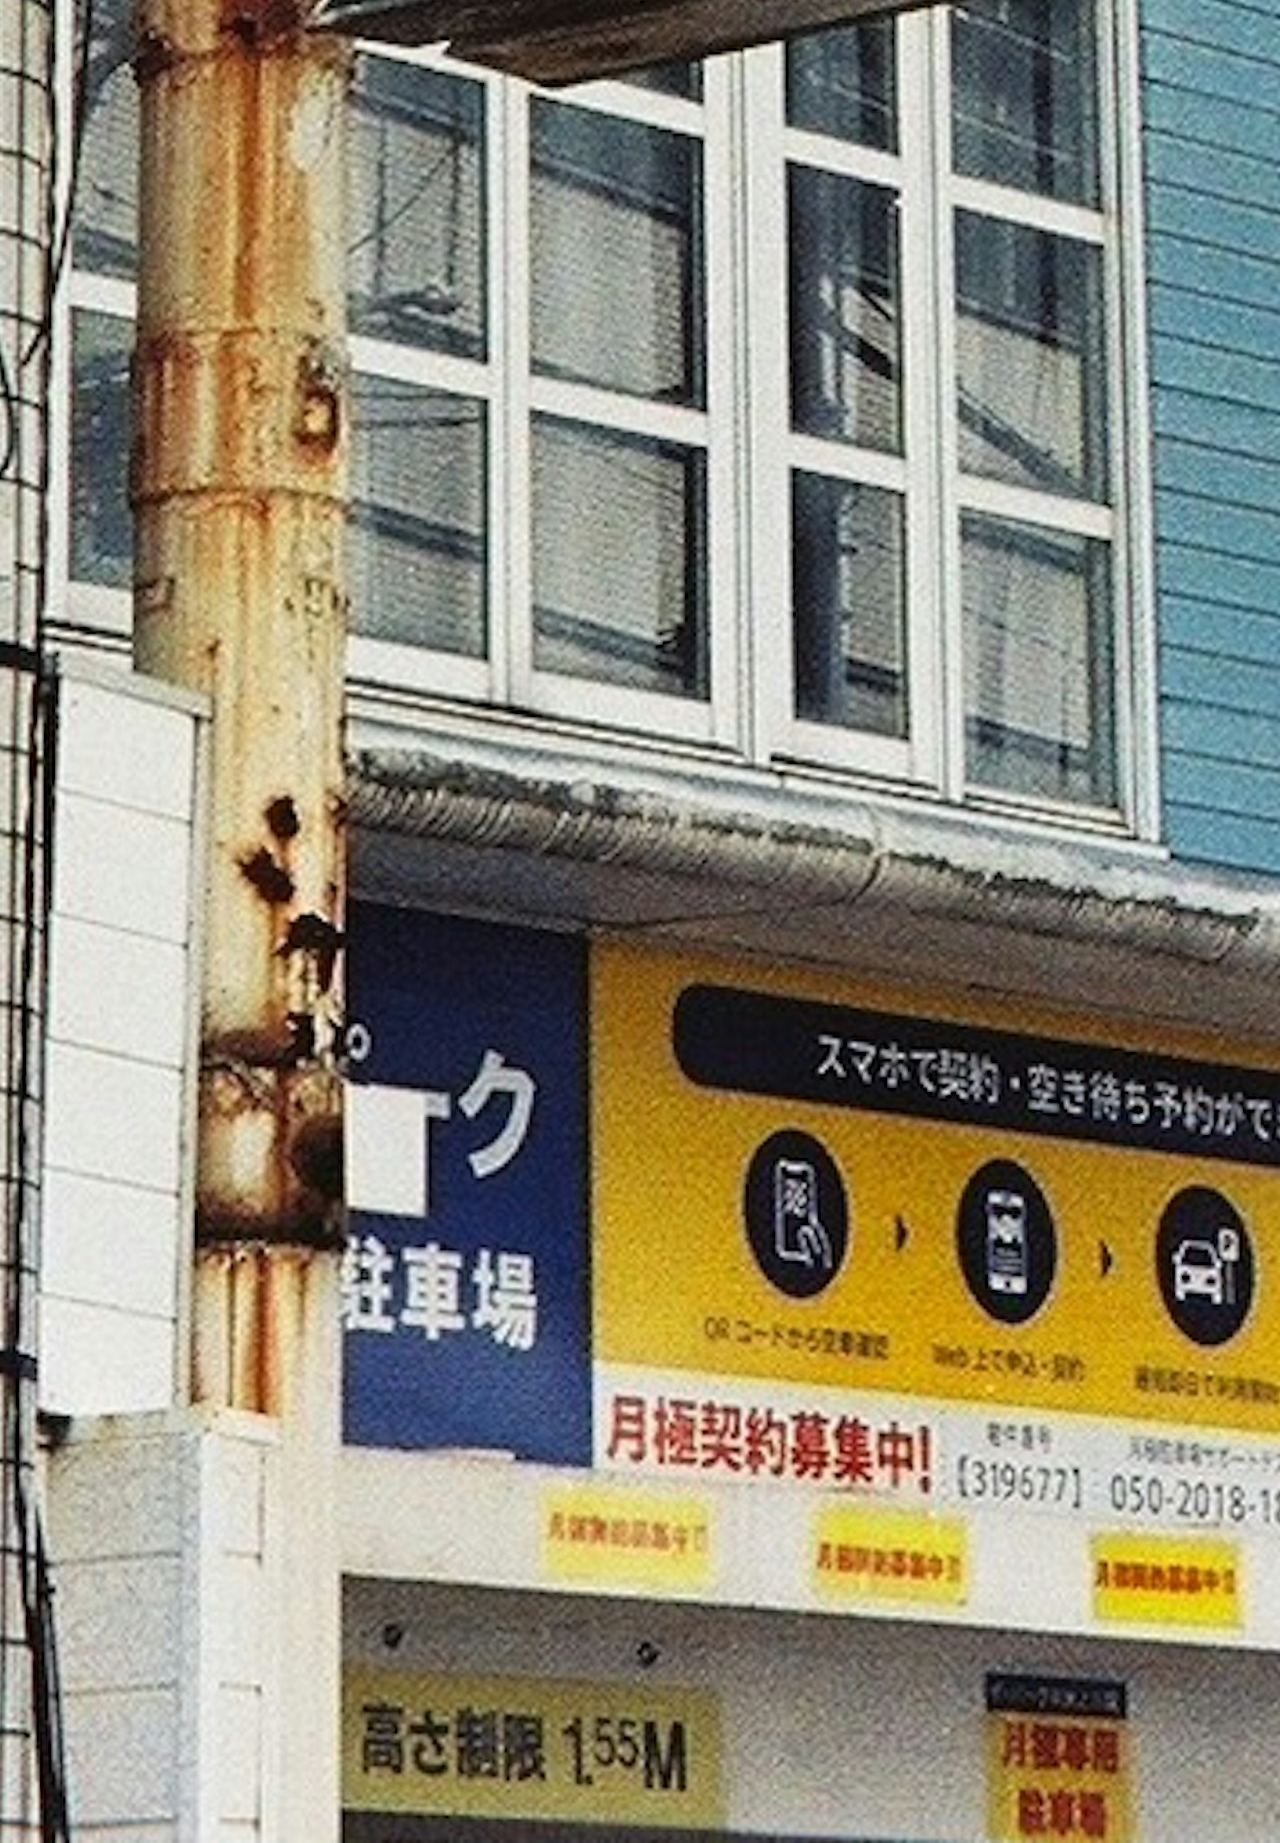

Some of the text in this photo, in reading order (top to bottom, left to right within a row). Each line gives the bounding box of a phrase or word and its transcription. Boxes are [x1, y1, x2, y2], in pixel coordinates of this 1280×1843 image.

[341, 1236, 538, 1351] 駐車場
[362, 1701, 547, 1782] 高さ制限
